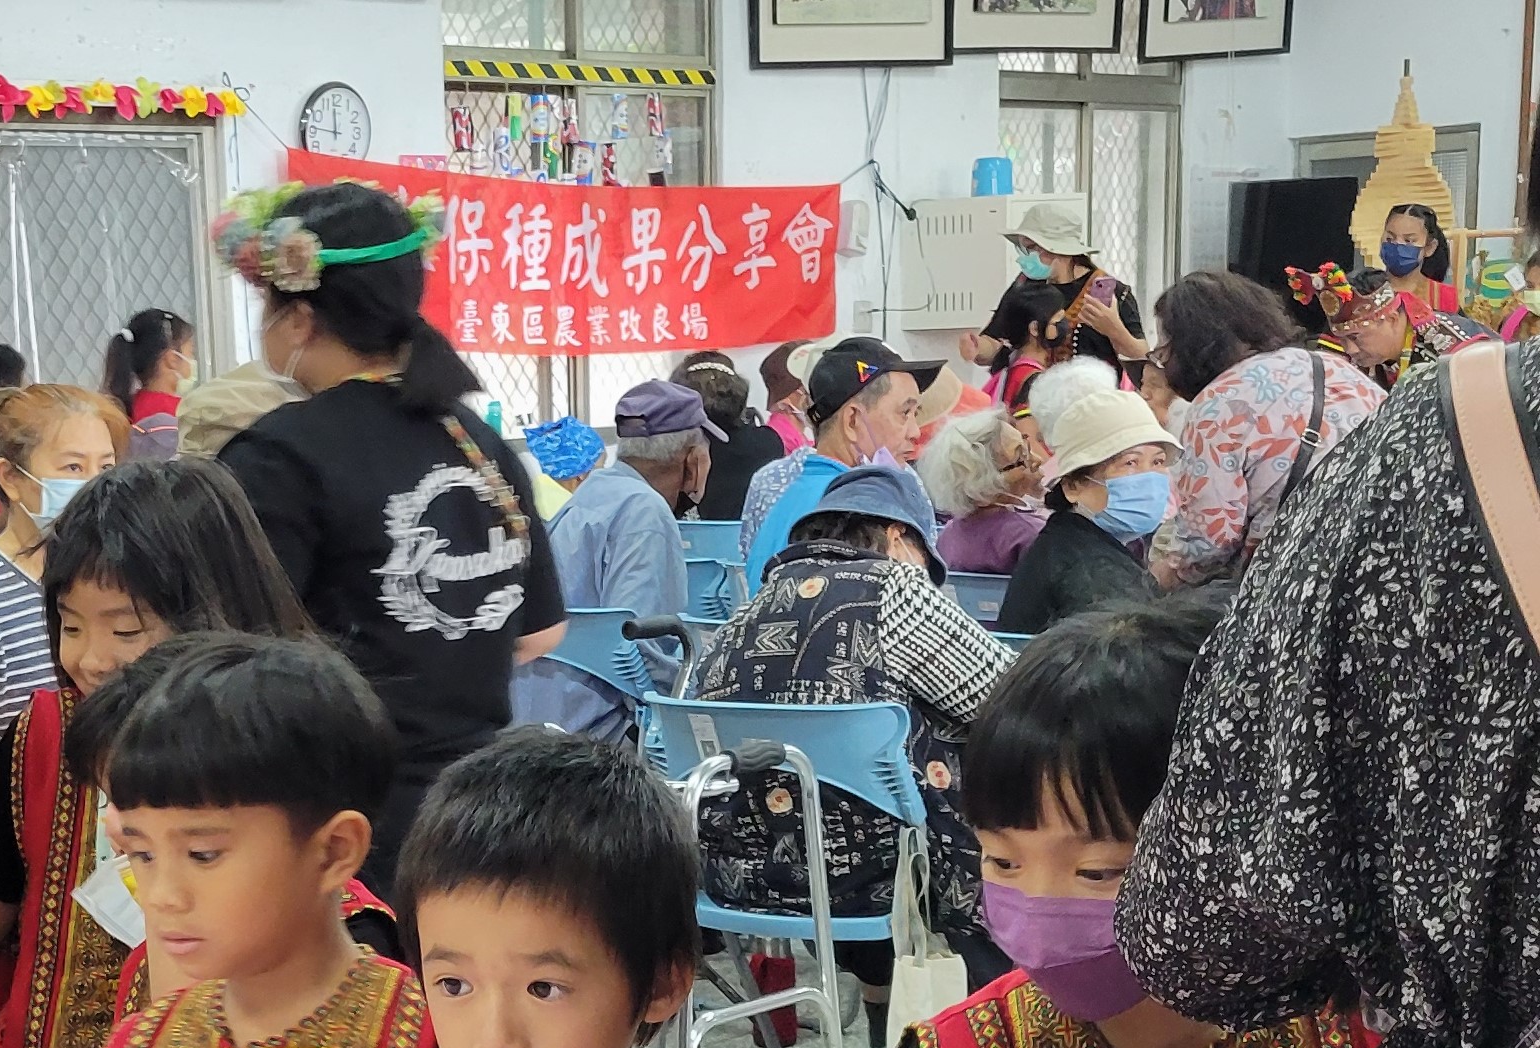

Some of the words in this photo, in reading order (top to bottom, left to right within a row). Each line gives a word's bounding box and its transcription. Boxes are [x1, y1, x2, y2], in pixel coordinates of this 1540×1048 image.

[350, 110, 359, 124] 2
[353, 127, 361, 140] 3
[348, 142, 358, 155] 4
[398, 194, 834, 298] 保種成果分享會
[455, 298, 709, 347] 臺東區農業改良場
